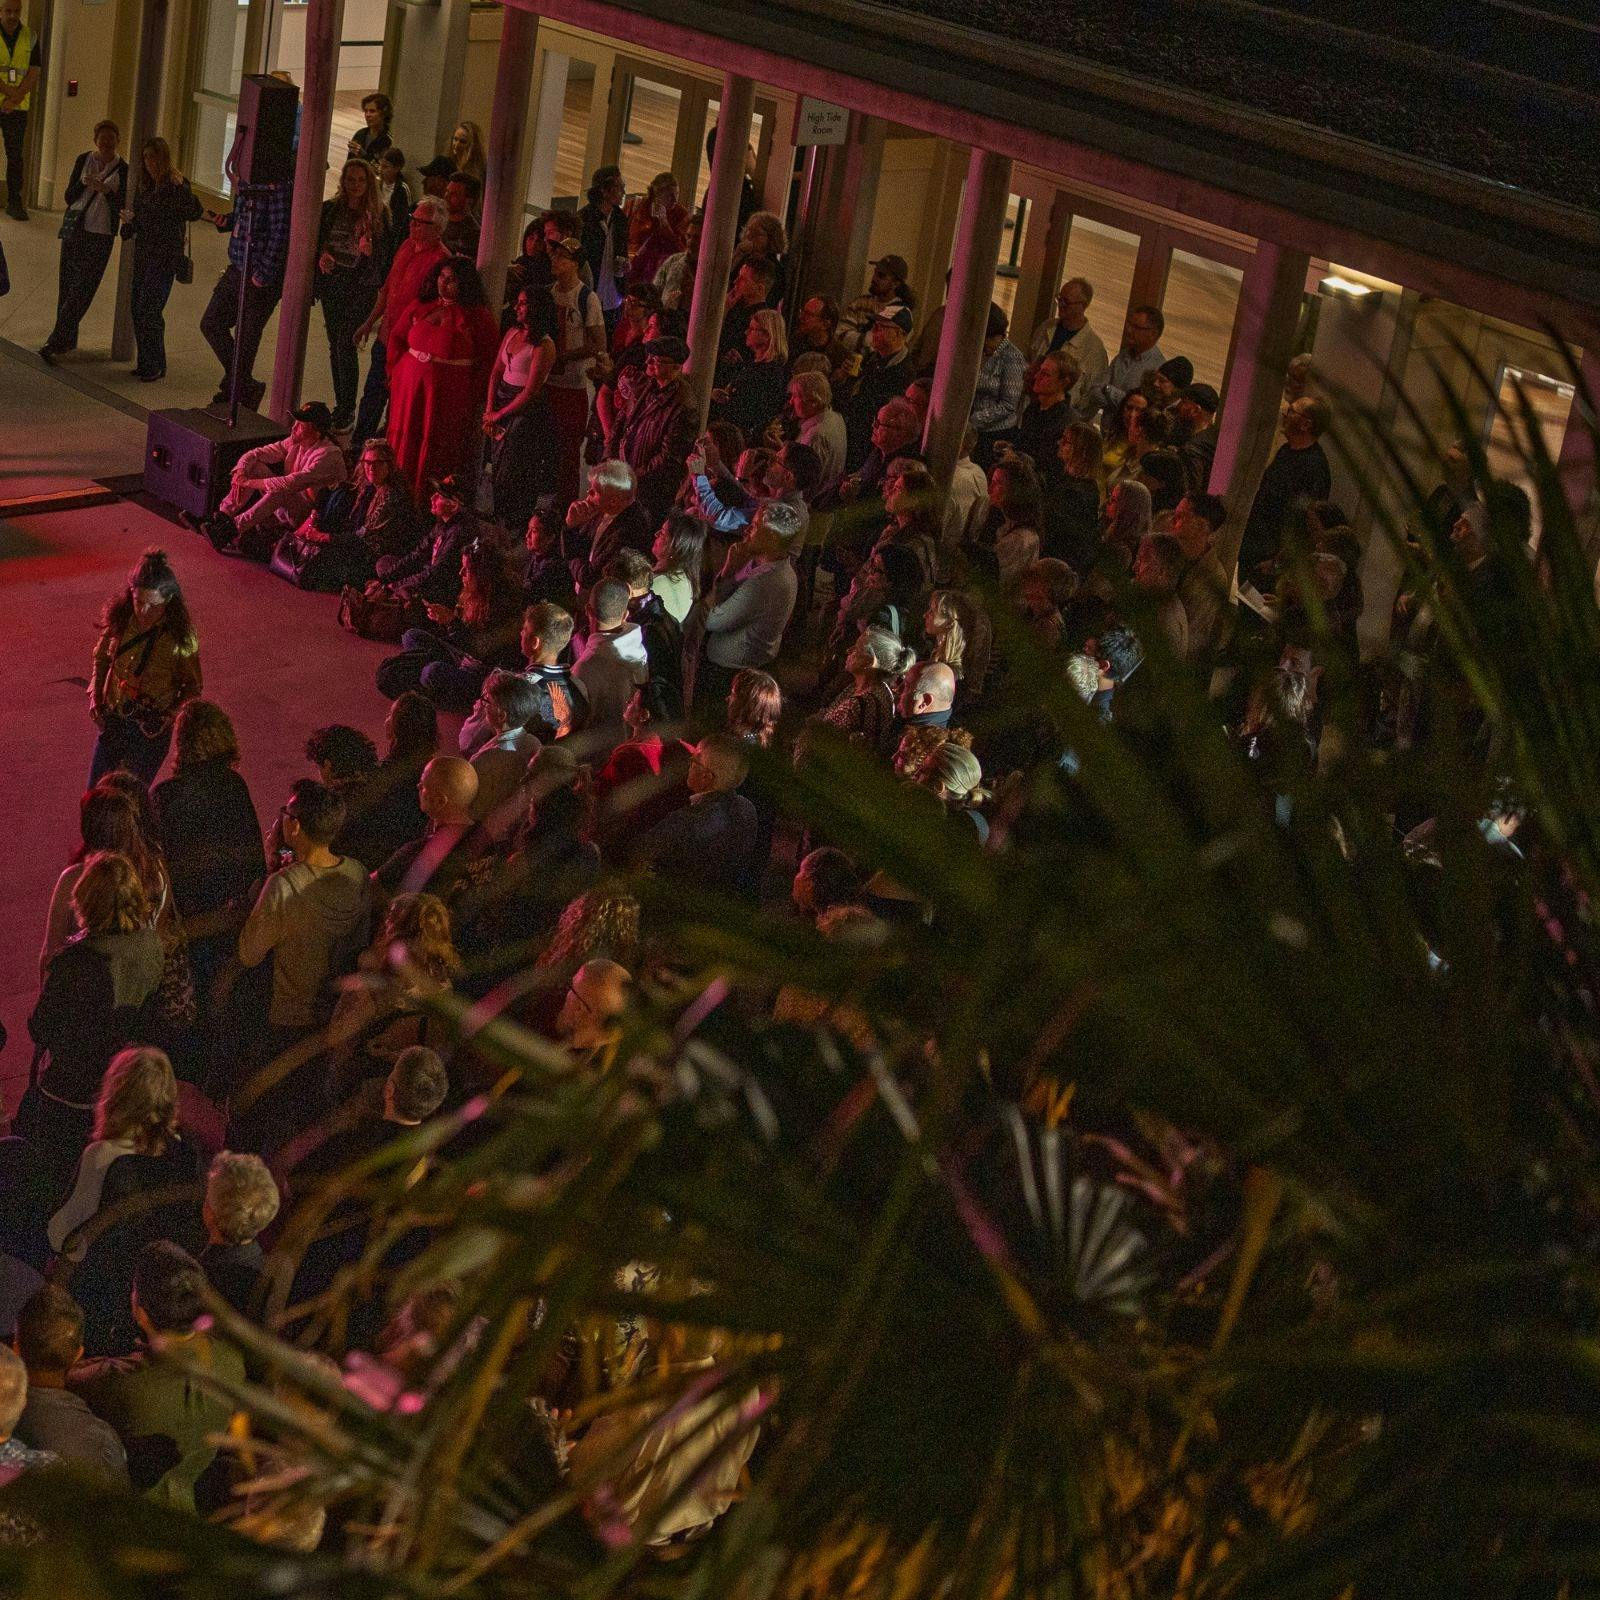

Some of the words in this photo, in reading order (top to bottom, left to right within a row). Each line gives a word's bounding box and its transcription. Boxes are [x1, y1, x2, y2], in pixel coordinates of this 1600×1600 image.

[808, 111, 824, 124] High
[827, 112, 841, 122] Tide
[813, 126, 833, 134] Room
